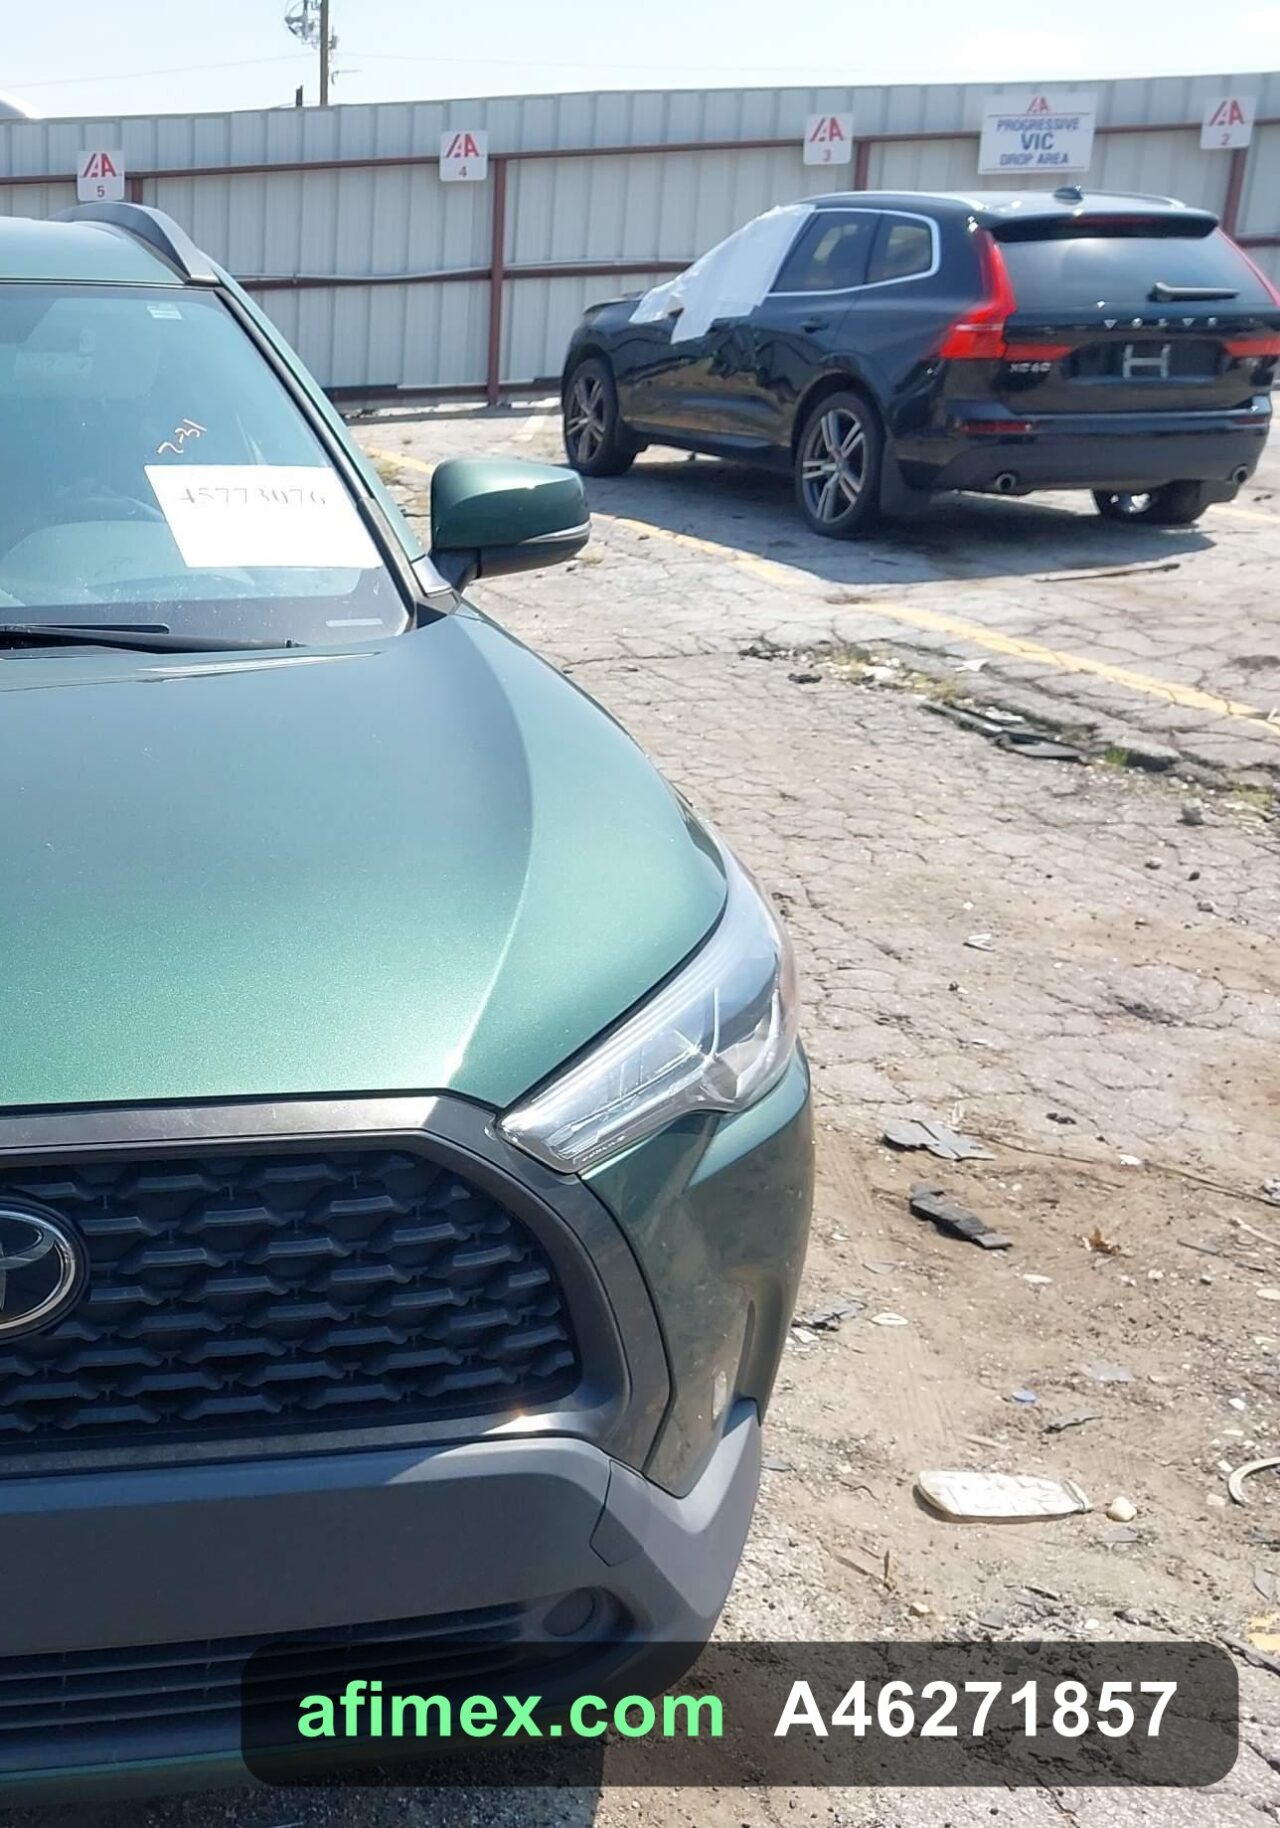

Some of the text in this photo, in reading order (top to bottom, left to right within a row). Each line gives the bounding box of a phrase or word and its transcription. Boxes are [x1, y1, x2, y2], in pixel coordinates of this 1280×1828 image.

[996, 117, 1080, 131] PROGRESSIVE
[1021, 132, 1054, 150] VIC
[1221, 132, 1231, 146] 2
[822, 149, 832, 162] 3
[1000, 152, 1068, 166] DROP AREA
[458, 165, 468, 177] 4
[97, 185, 106, 198] 5
[1102, 316, 1217, 329] VOLVO
